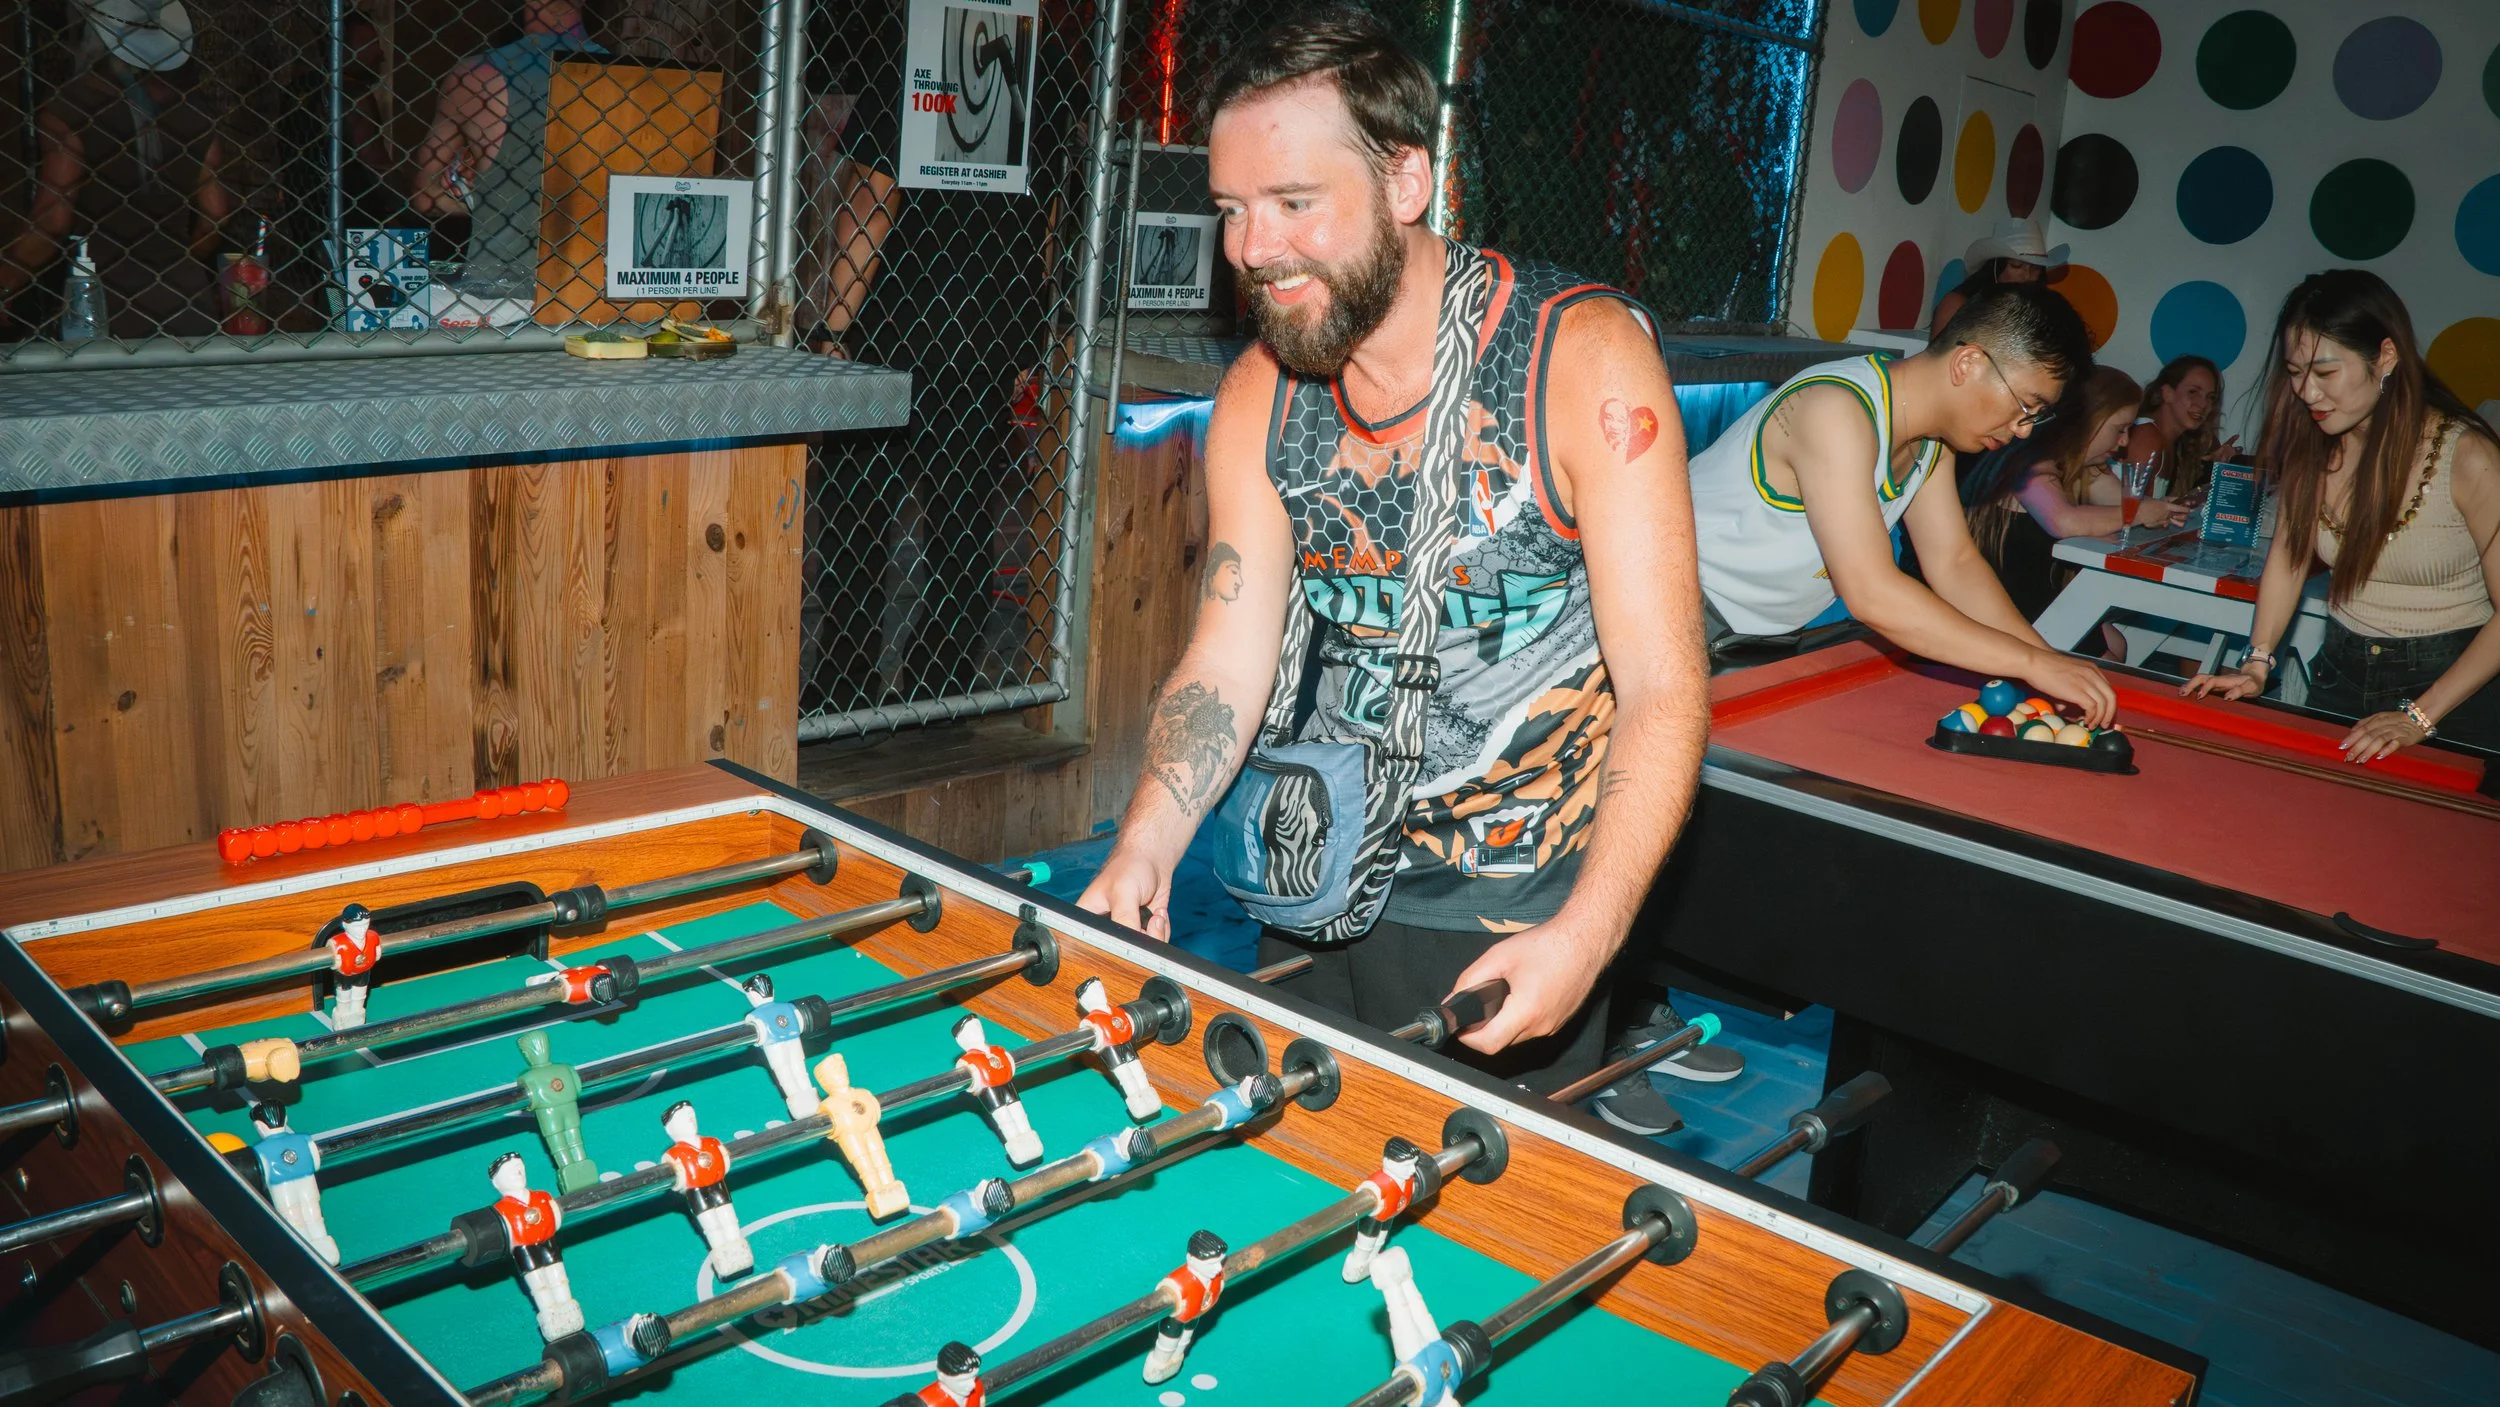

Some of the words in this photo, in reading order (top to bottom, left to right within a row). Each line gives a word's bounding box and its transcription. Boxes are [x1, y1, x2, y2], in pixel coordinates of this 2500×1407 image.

[913, 68, 932, 79] AXE
[913, 79, 959, 93] THROWING
[912, 92, 958, 115] 100K
[919, 165, 960, 177] REGISTER
[960, 167, 971, 178] AT
[972, 168, 1008, 180] CASHIER
[941, 178, 960, 187] Everyday
[617, 271, 681, 285] MAXIMUM
[684, 271, 692, 285] 4
[695, 271, 739, 285] PEOPLE
[648, 287, 680, 295] PERSON
[683, 287, 698, 295] PER
[700, 286, 719, 296] LINE)
[1129, 287, 1166, 299] AXIMUM
[1167, 287, 1173, 299] 4
[1175, 288, 1205, 299] PEOPLE
[1143, 299, 1165, 307] PERSON
[1166, 299, 1177, 307] PER
[1177, 299, 1191, 307] LINE)
[1471, 524, 1487, 534] NBA
[903, 1260, 951, 1287] SPORTS
